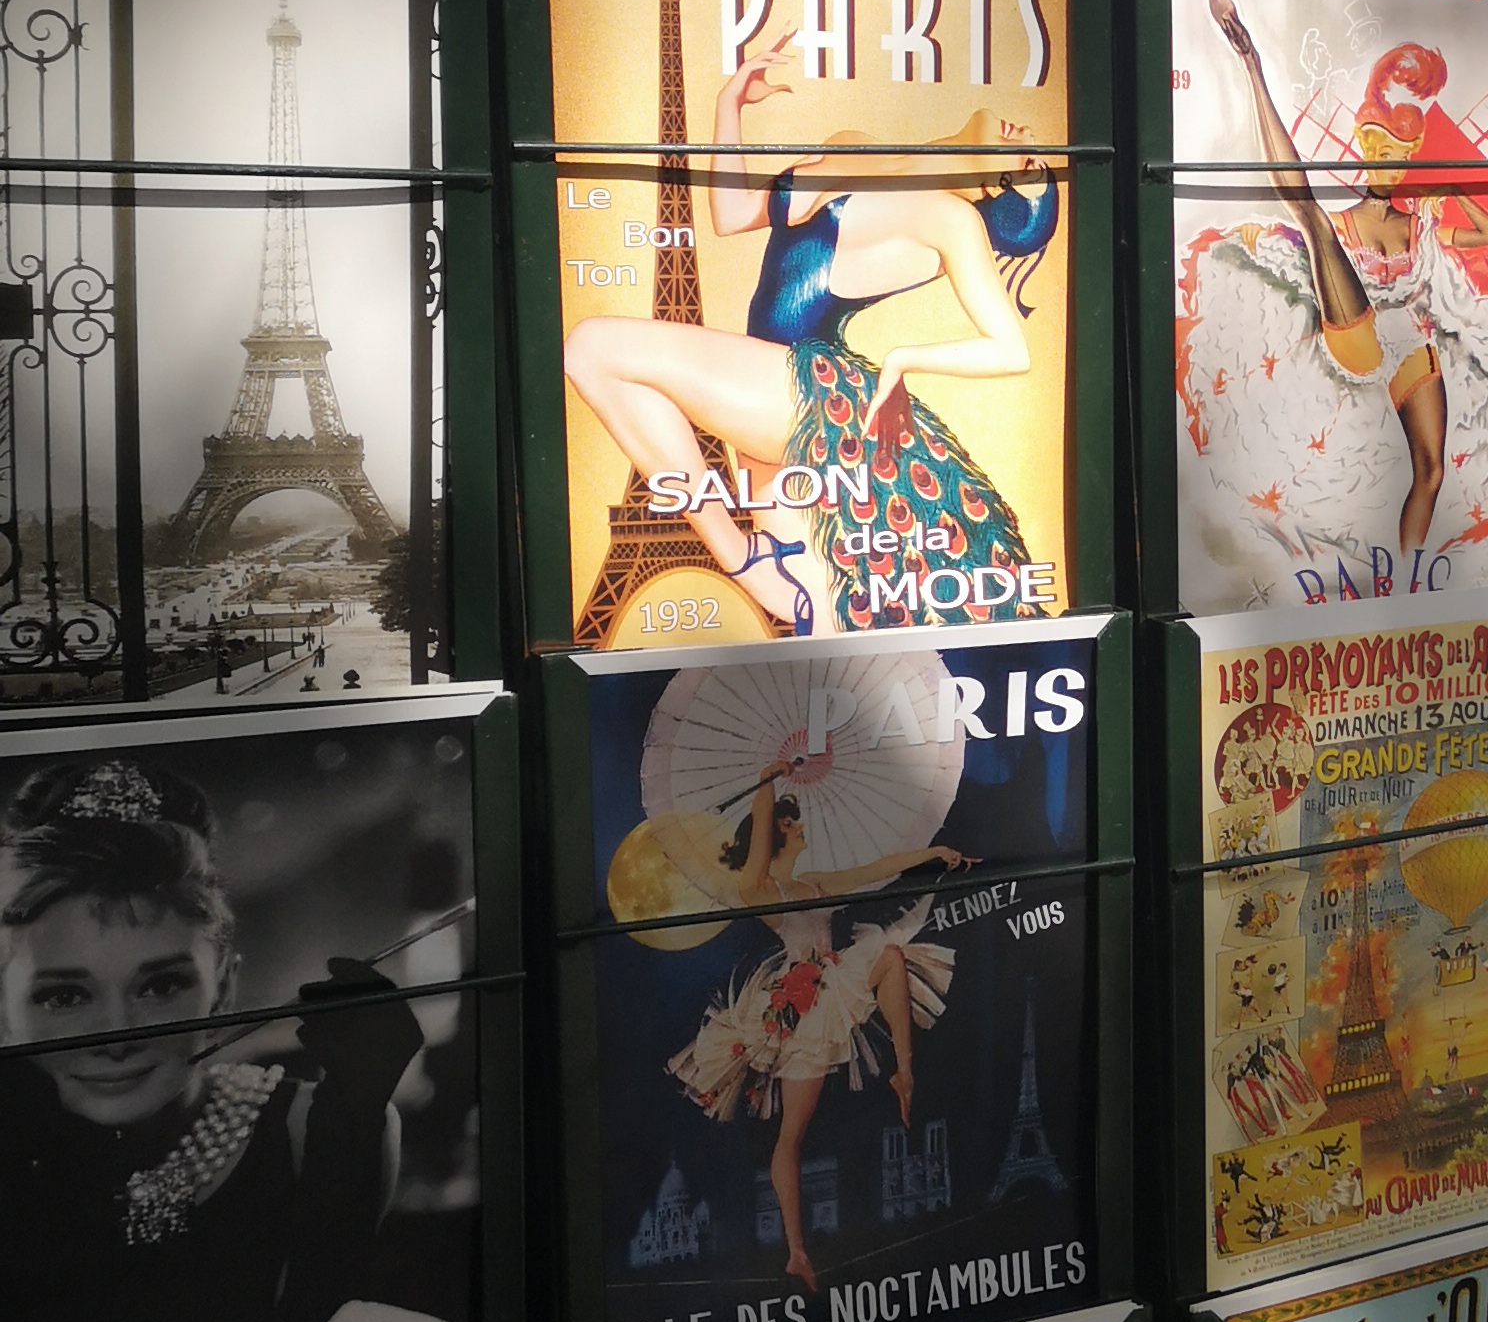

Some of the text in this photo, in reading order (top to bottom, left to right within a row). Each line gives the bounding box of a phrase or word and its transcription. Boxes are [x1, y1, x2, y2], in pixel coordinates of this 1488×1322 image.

[567, 182, 611, 209] Le
[623, 221, 694, 248] Bon
[567, 260, 637, 286] Ton
[647, 464, 871, 514] SALON
[844, 521, 949, 555] de la
[869, 562, 1056, 613] MODE
[640, 599, 722, 634] 1932
[1218, 658, 1260, 705] LES
[1354, 695, 1380, 710] DES
[1385, 682, 1420, 707] 10
[807, 667, 1086, 756] PARIS
[1315, 711, 1408, 743] DIMANCHE
[1413, 703, 1444, 730] 13
[1315, 740, 1428, 785] GRANDE
[1317, 786, 1357, 816] JOUR
[1382, 776, 1416, 805] NUIT
[932, 881, 1021, 933] RENDEZ
[1007, 900, 1065, 941] VOUS
[1385, 1174, 1439, 1216] CHAMP
